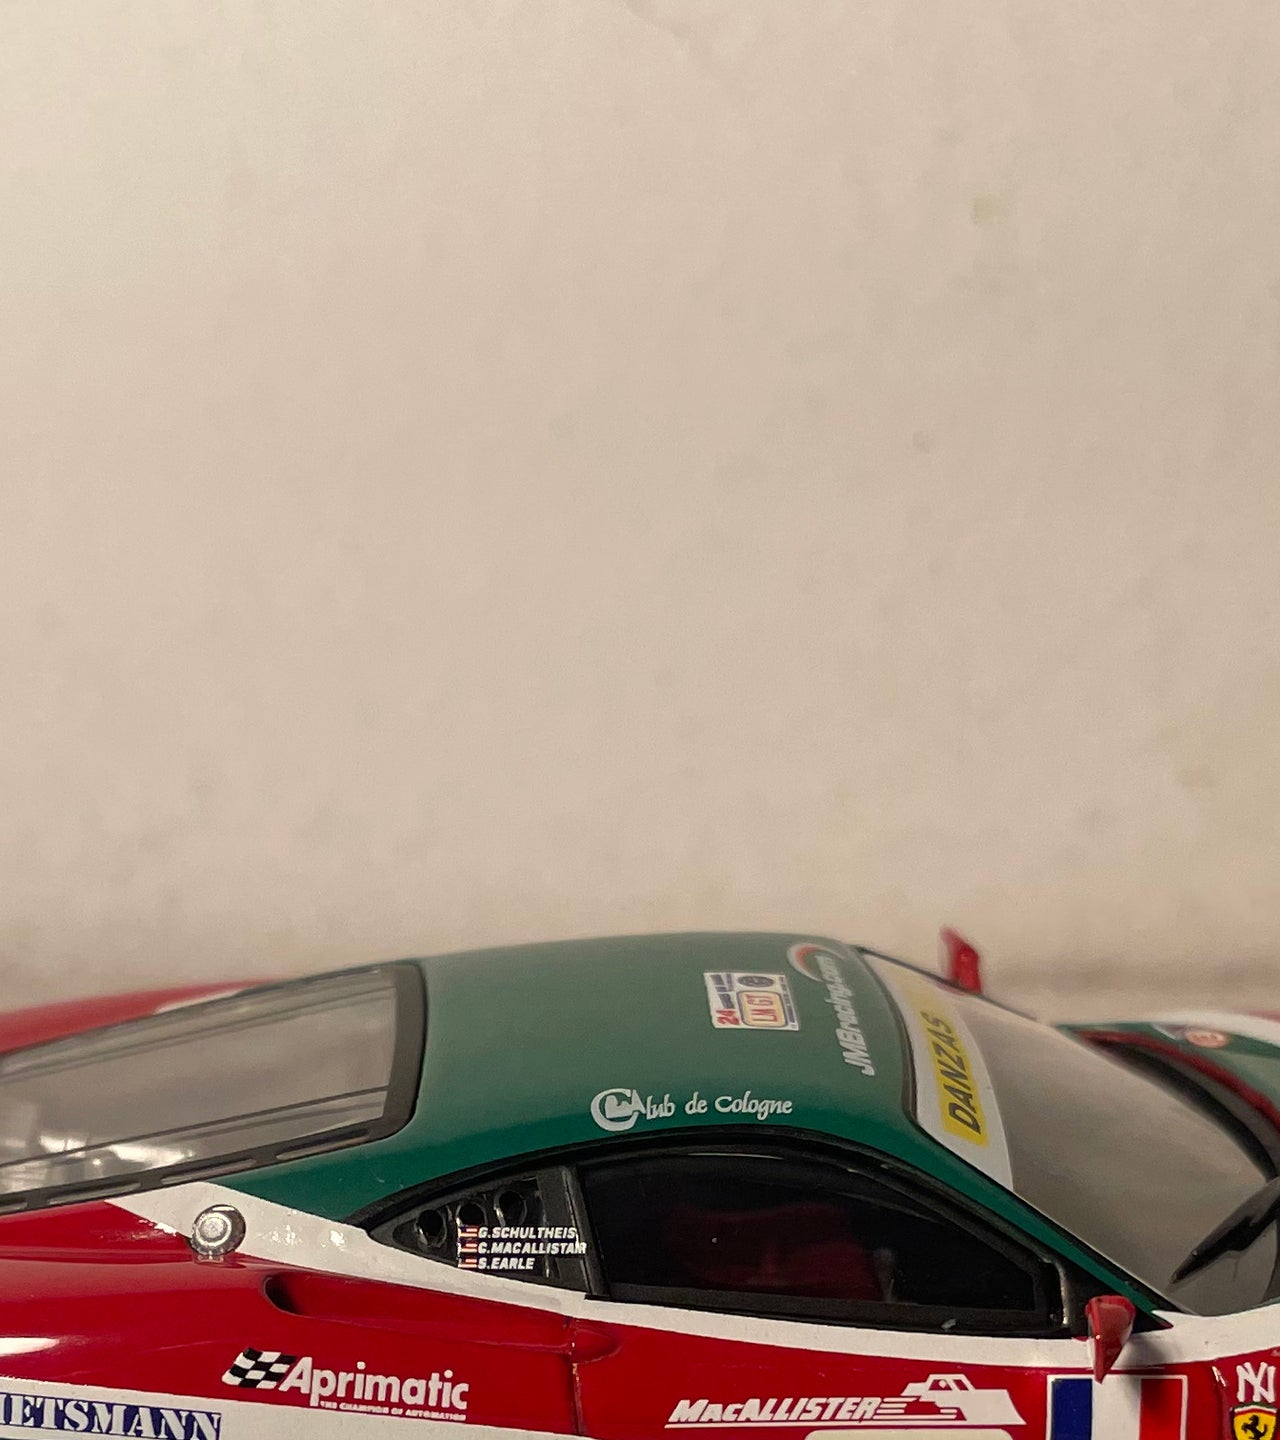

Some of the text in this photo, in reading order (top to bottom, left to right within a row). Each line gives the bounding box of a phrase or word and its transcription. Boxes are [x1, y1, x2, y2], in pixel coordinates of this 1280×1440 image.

[921, 1011, 982, 1136] DANZAS
[684, 1091, 708, 1115] de
[715, 1090, 794, 1121] Cologne
[278, 1356, 470, 1410] Aprimatic
